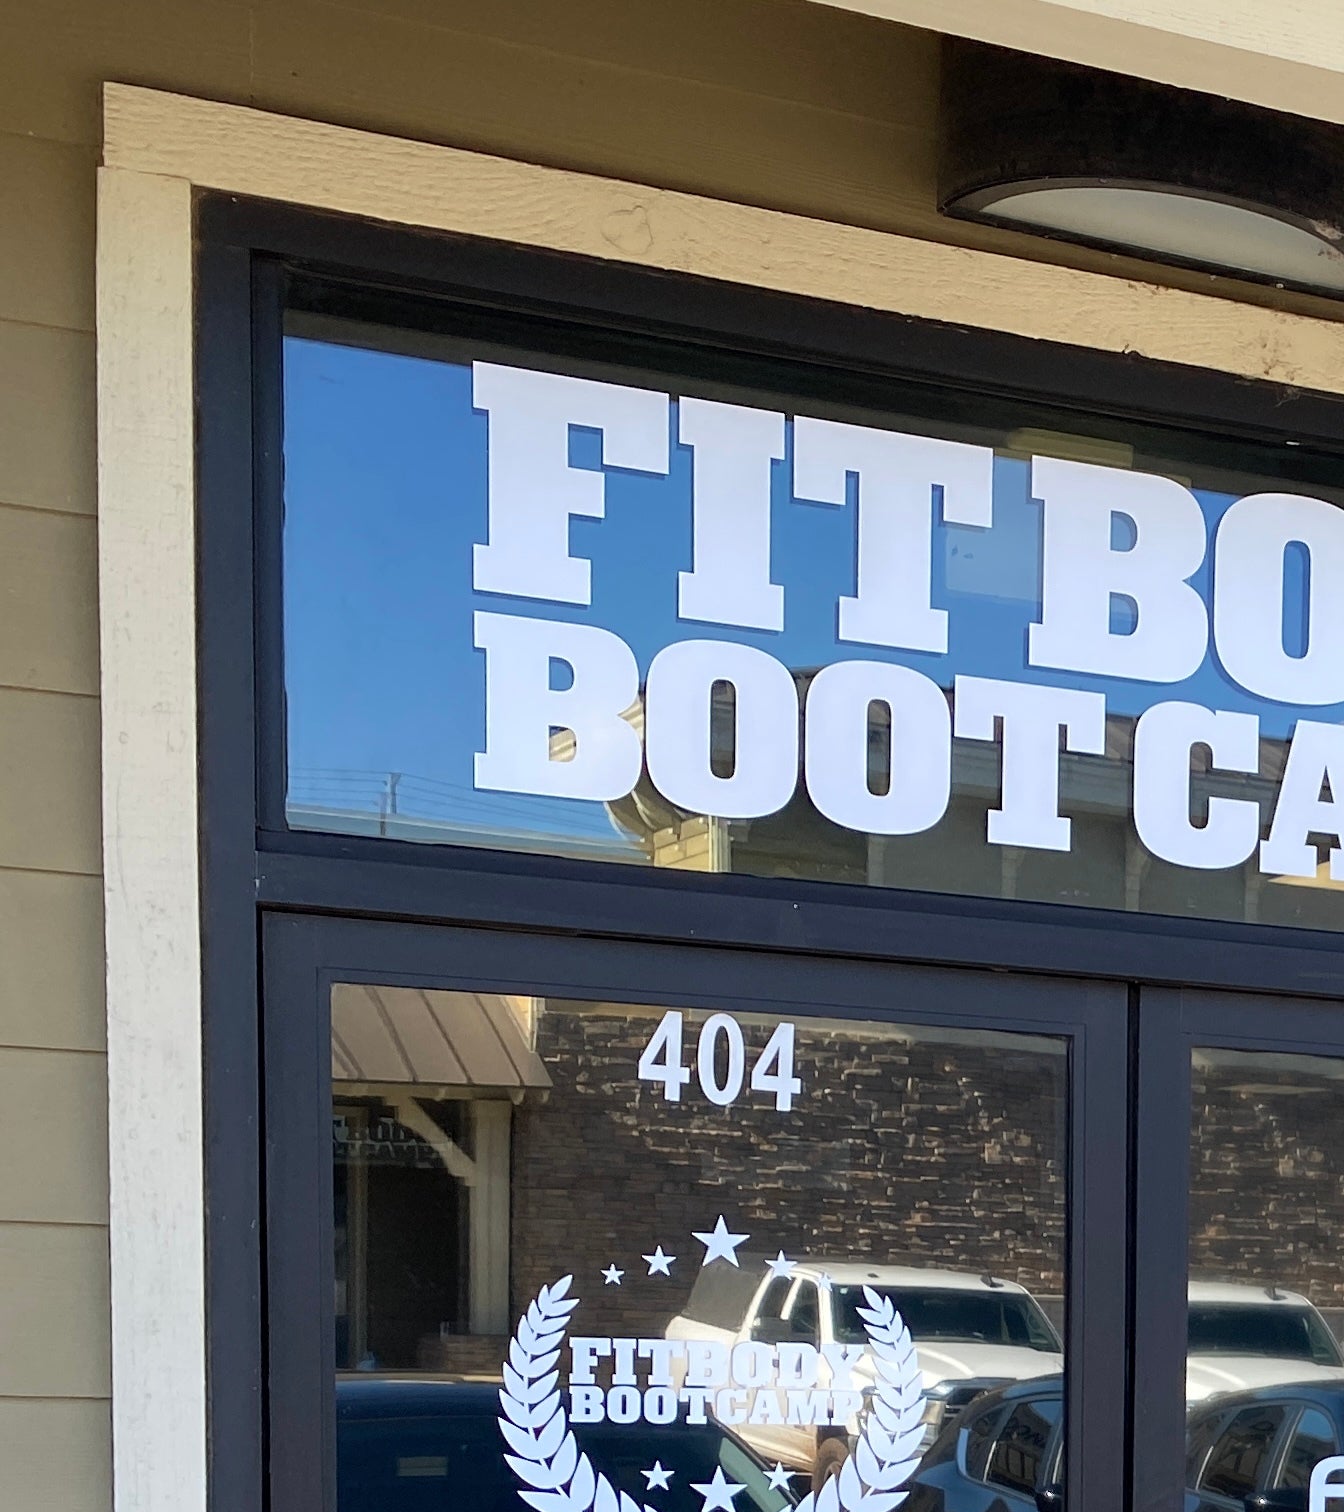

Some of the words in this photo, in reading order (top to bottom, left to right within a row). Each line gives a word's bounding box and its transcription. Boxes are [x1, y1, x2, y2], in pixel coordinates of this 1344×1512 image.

[472, 360, 994, 655] FIT
[472, 611, 1106, 852] BOOT
[637, 1010, 802, 1112] 404
